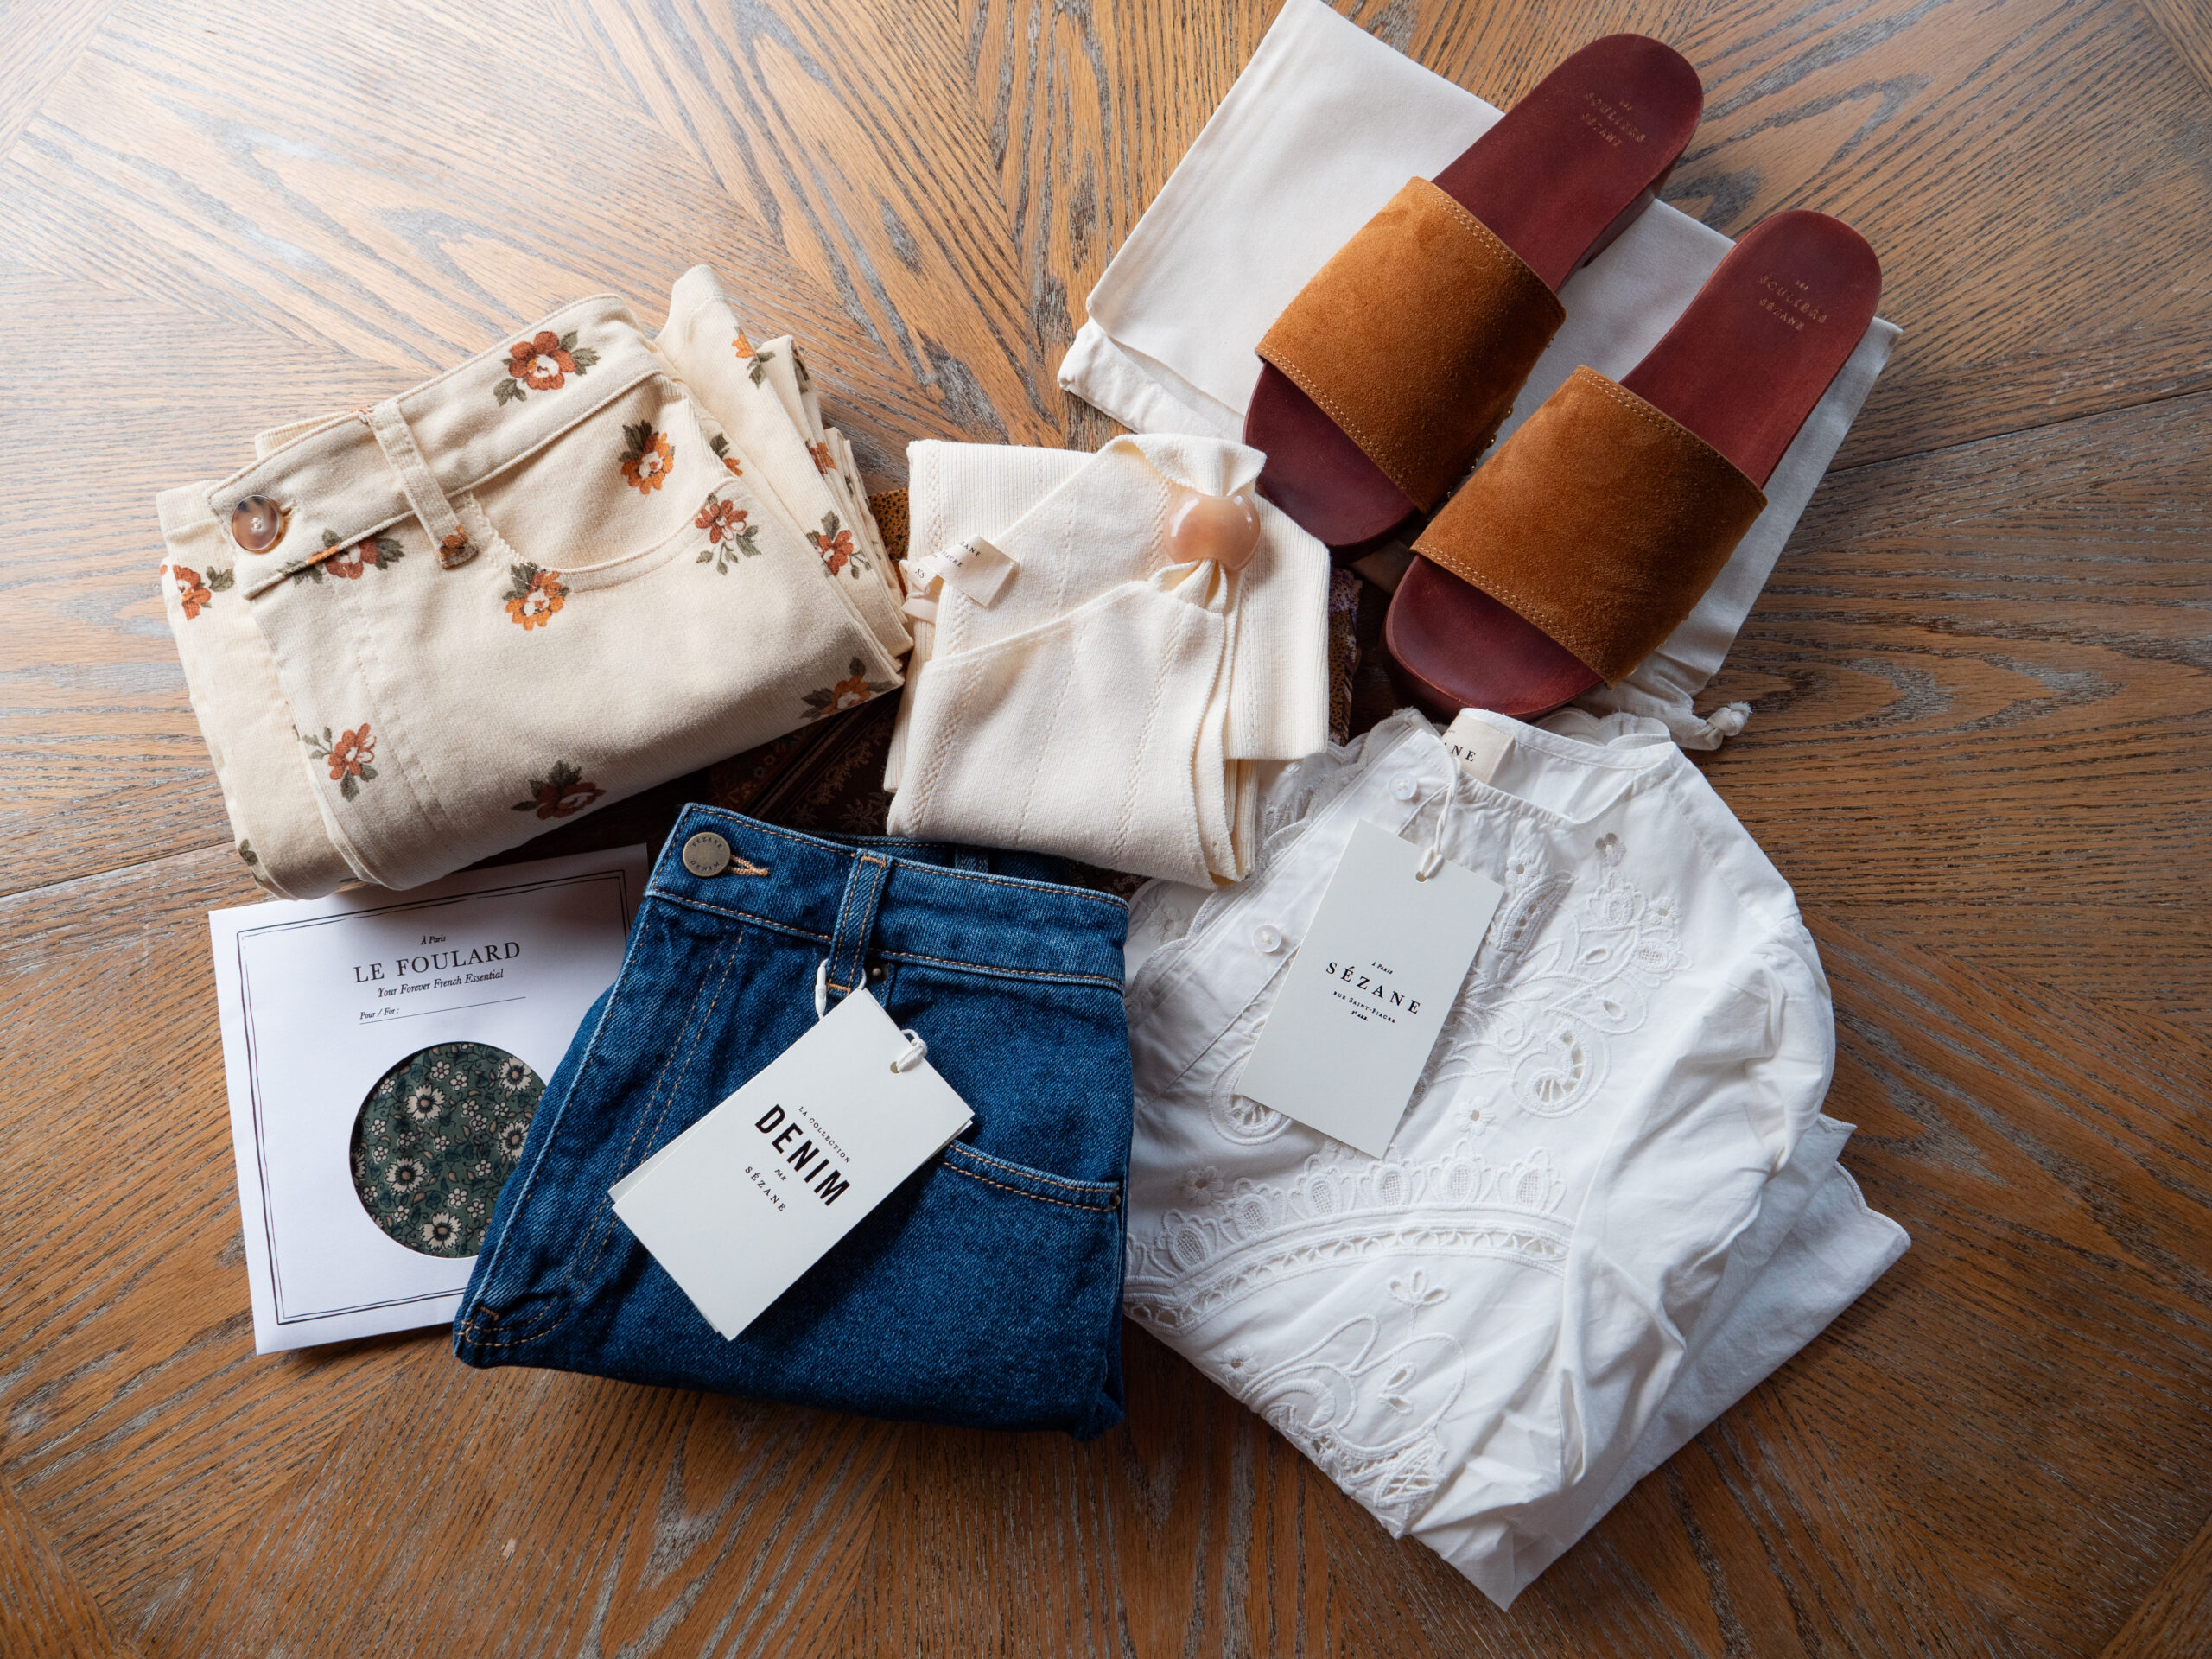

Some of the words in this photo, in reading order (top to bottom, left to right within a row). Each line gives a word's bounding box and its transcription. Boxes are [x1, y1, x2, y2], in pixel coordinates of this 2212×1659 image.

[1759, 275, 1827, 324] SOULIERS
[914, 568, 926, 579] XS
[1444, 741, 1477, 762] NE
[420, 935, 427, 945] À
[429, 933, 447, 945] Paris
[353, 963, 385, 983] LE
[395, 941, 521, 977] FOULARD
[378, 987, 398, 998] Your
[399, 982, 431, 995] Forever
[433, 976, 463, 990] French
[465, 968, 505, 985] Essential
[1325, 962, 1421, 1014] SÉZANE
[359, 1010, 377, 1020] Pour
[798, 1106, 808, 1117] LA
[809, 1117, 851, 1164] COLLECTION
[754, 1103, 851, 1207] DENIM
[745, 1166, 786, 1212] SÉZANE
[774, 1168, 787, 1182] PAR
